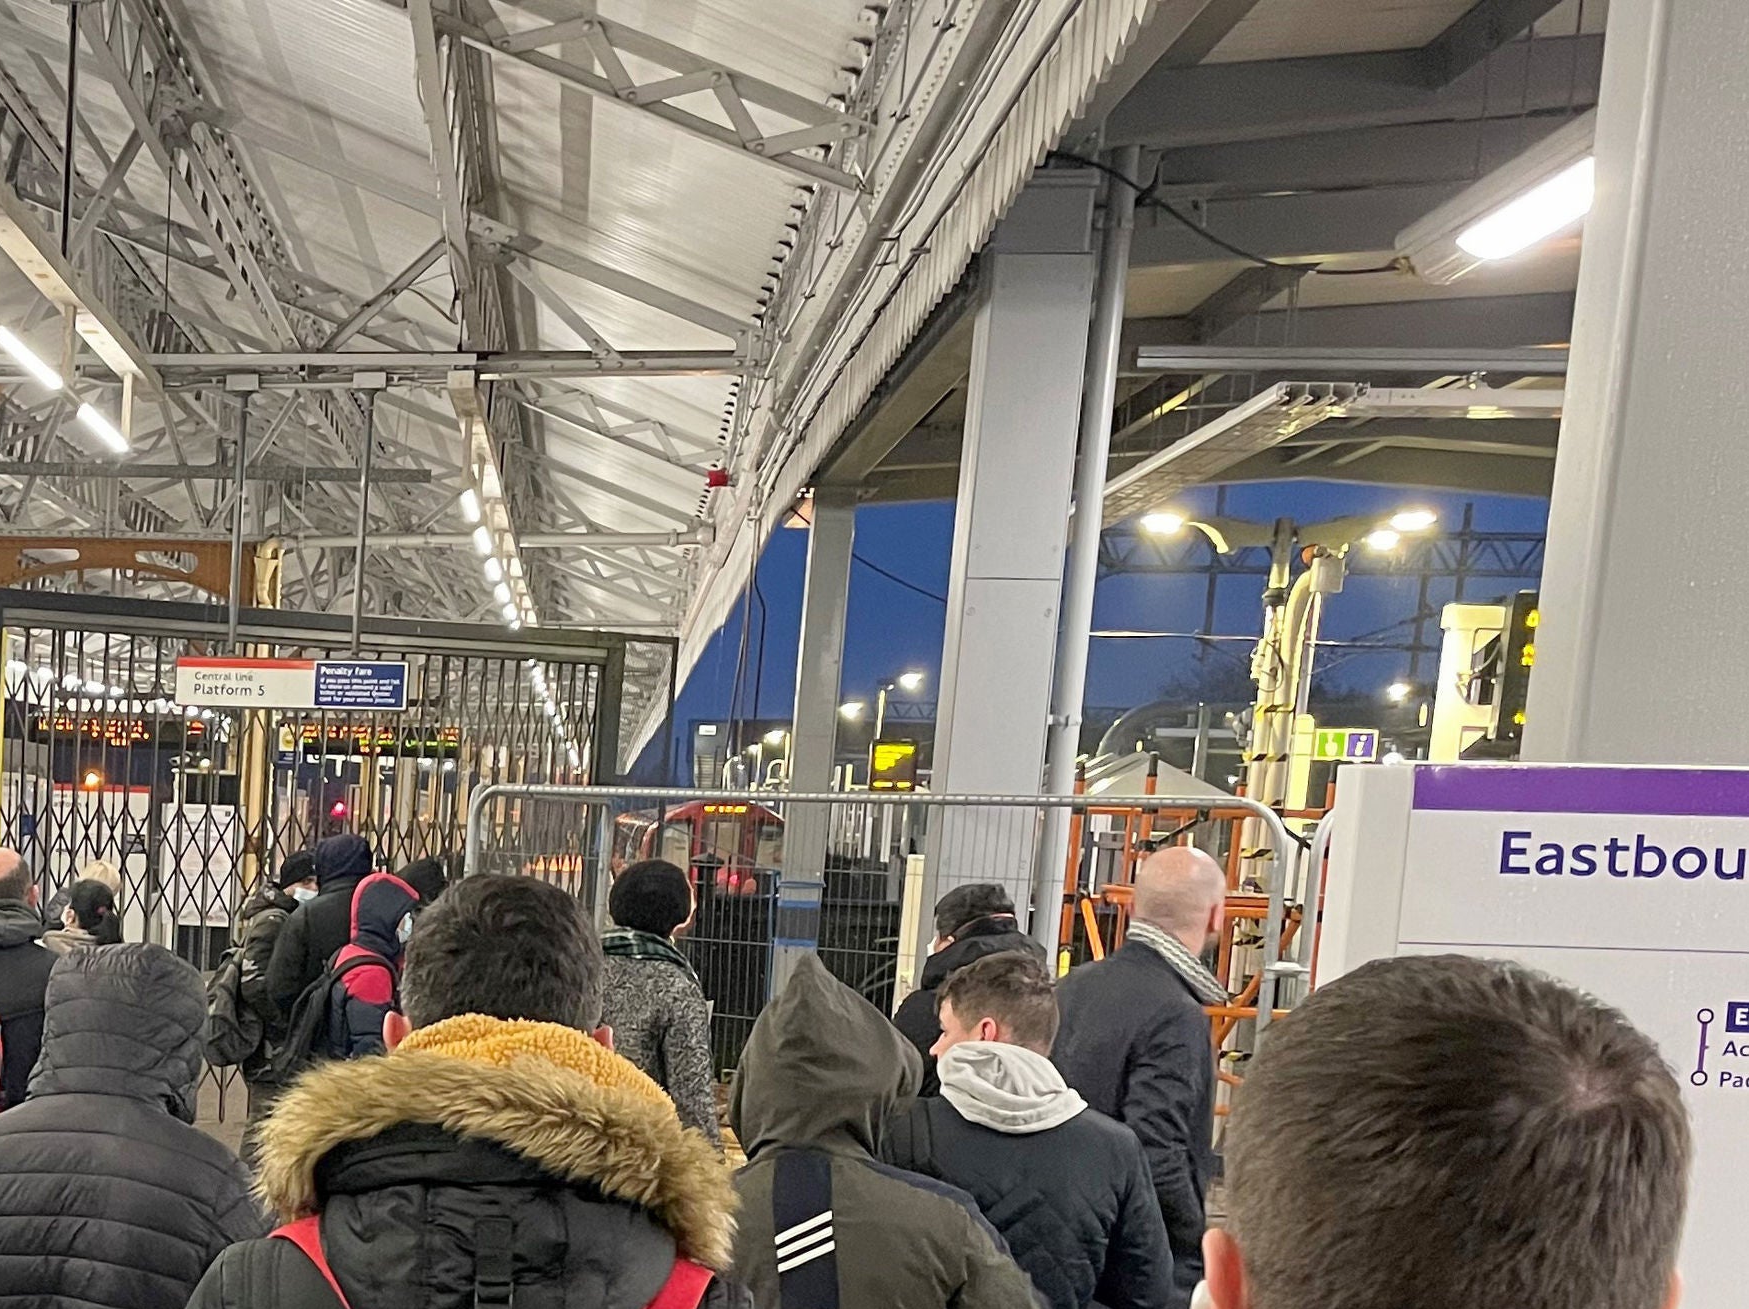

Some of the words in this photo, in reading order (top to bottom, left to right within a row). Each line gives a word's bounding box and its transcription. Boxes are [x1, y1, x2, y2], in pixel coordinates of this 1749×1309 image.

[194, 670, 232, 682] Central
[234, 671, 254, 683] line
[320, 666, 353, 677] Penalty
[193, 683, 252, 697] Platform
[257, 686, 266, 697] 5
[1499, 830, 1747, 881] Eastbou
